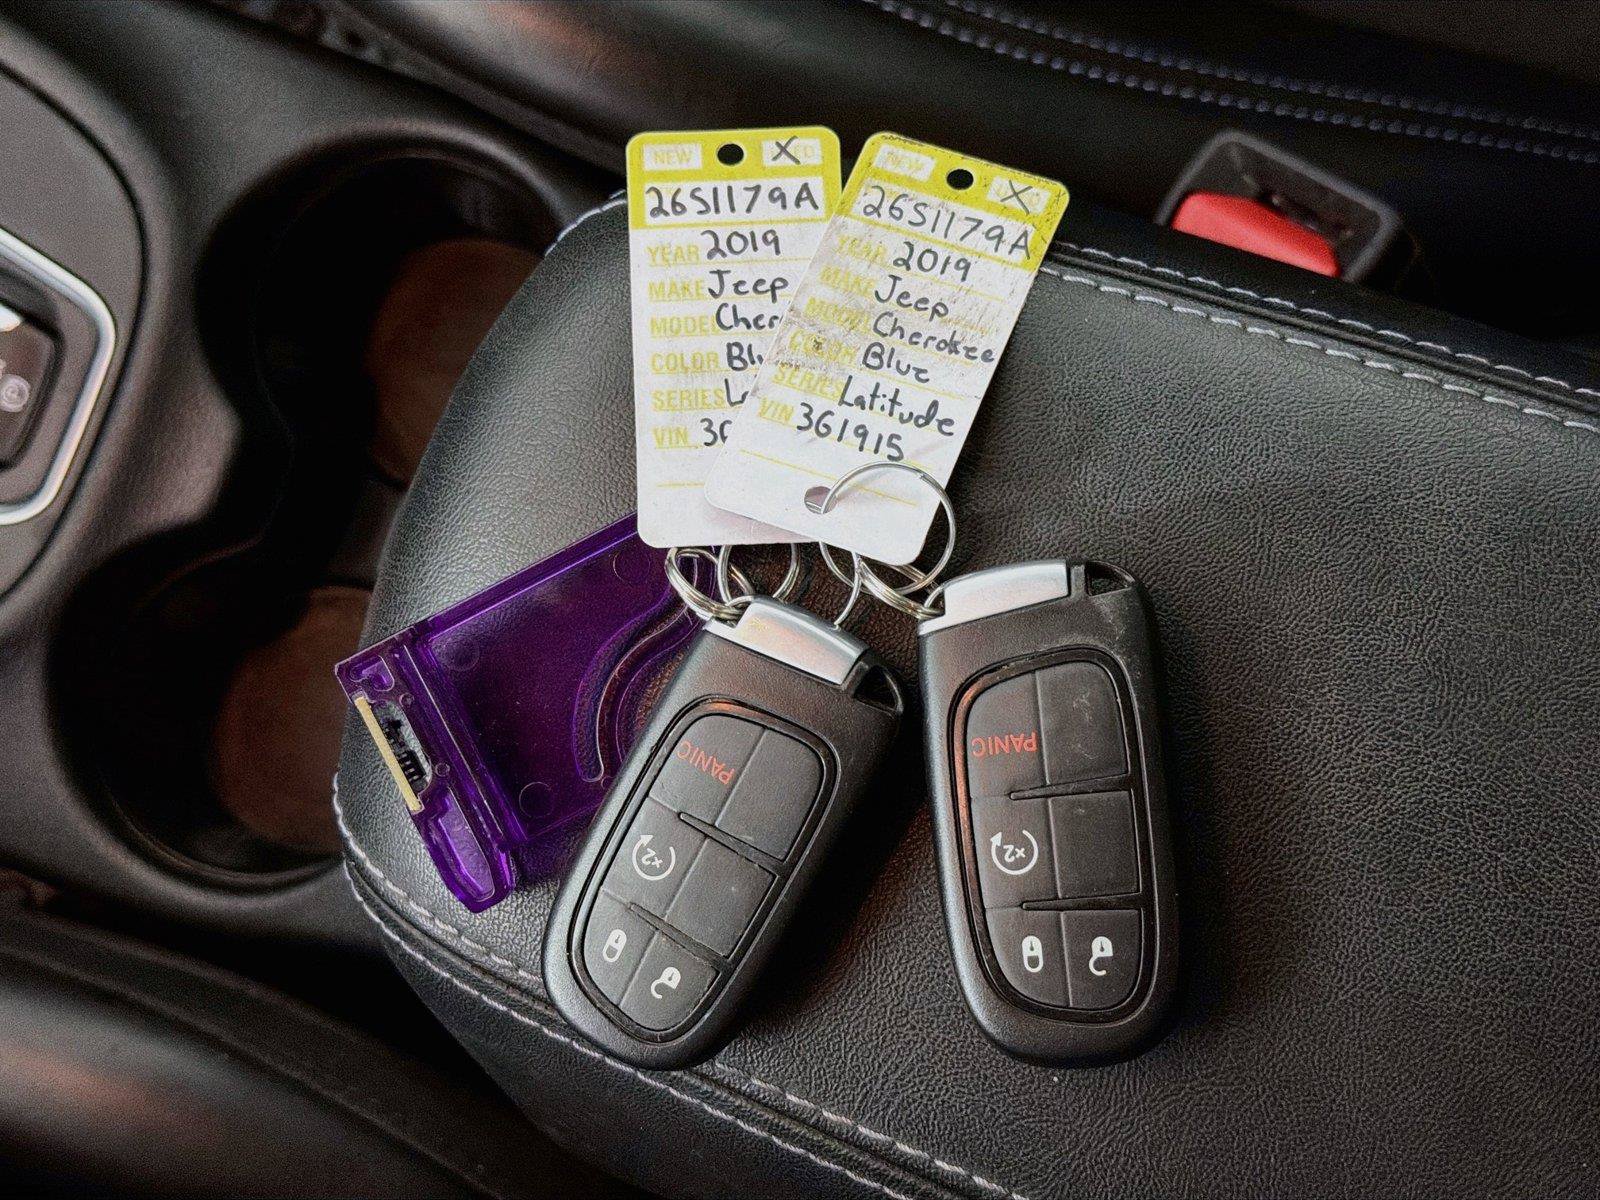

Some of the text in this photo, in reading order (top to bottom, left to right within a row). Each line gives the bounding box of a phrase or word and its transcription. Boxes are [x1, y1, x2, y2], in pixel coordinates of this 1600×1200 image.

[653, 150, 692, 165] NEW
[645, 182, 819, 218] 26S1179A
[862, 185, 1031, 260] 26S1179A
[647, 229, 781, 264] YEAR 2019
[893, 241, 971, 282] 2019
[648, 269, 788, 303] MAKE Jeep
[874, 274, 949, 322] Jeep
[873, 311, 995, 363] Cherokee
[651, 351, 719, 373] COLOR
[862, 341, 930, 384] Blue
[652, 387, 725, 411] SERIES
[772, 364, 955, 436] SERIES Latitude
[653, 426, 689, 448] VIN
[758, 397, 904, 462] VIN 361915
[675, 740, 735, 785] PANIC
[971, 730, 1038, 758] PANIC
